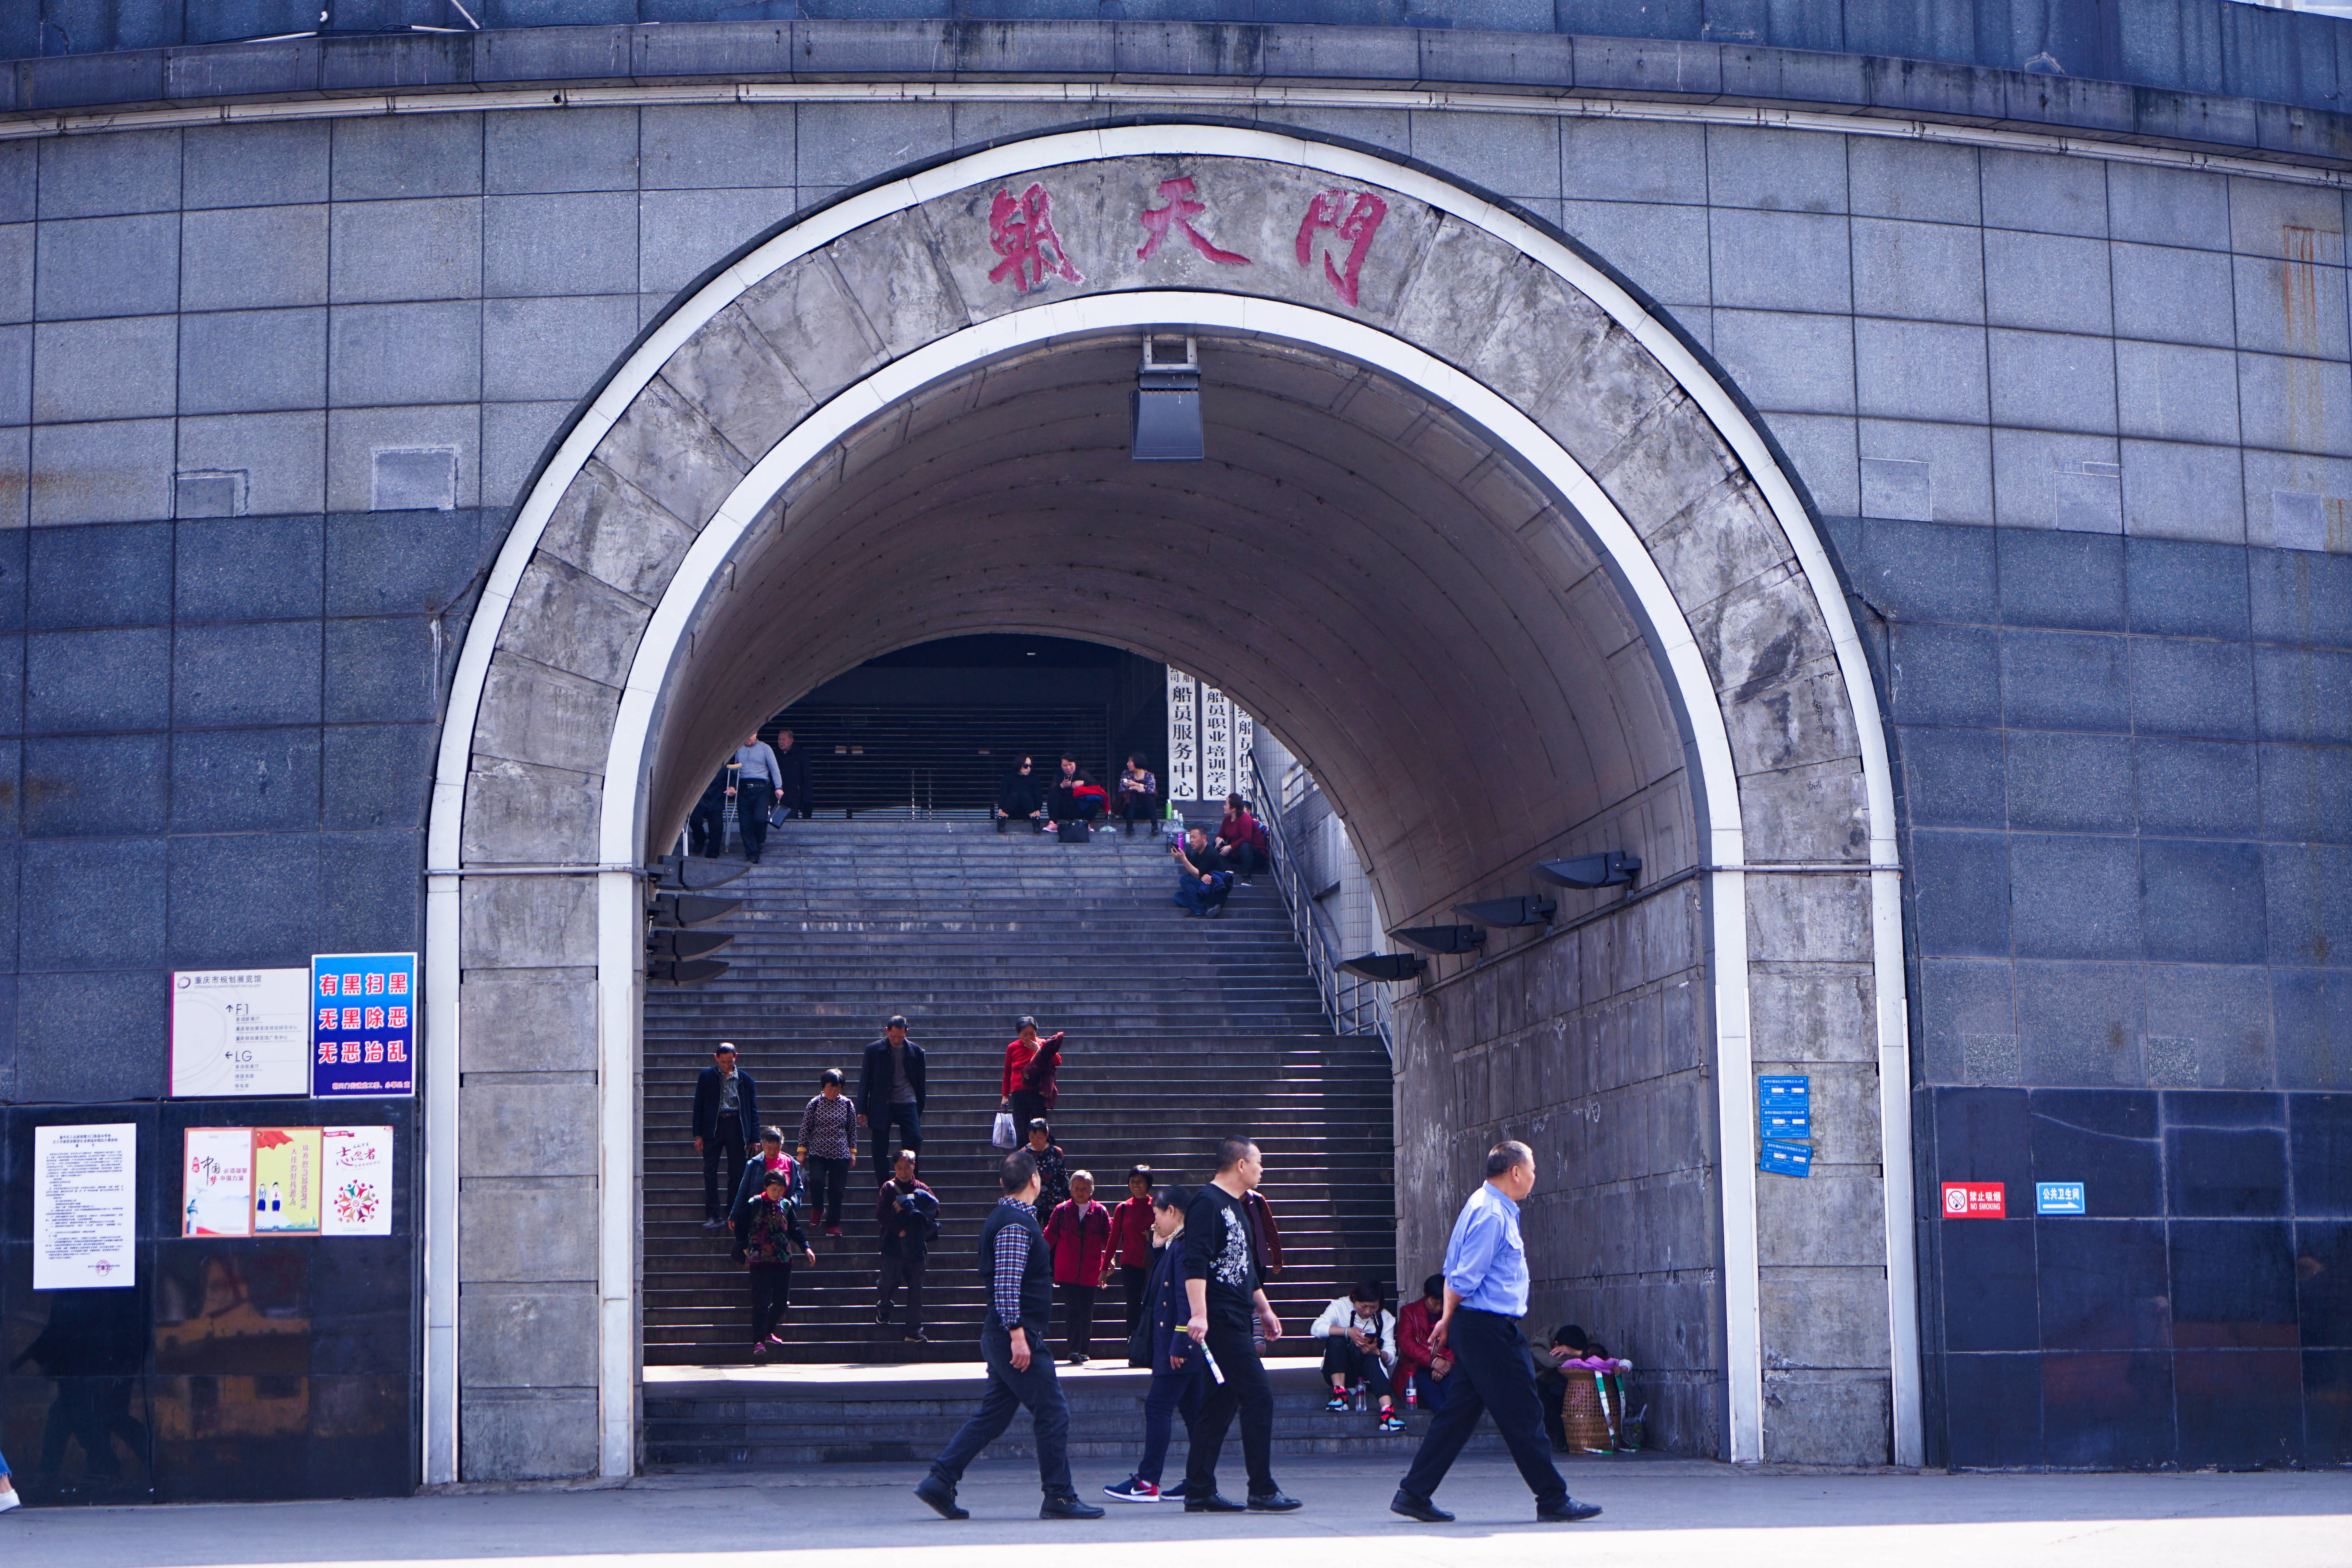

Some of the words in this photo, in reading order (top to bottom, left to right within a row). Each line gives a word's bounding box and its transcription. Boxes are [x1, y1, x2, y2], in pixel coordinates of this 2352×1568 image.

[1172, 686, 1194, 797] 船员服务中心
[1206, 686, 1227, 797] 船员职业培训学校
[194, 975, 262, 984] 重庆市规划展览馆
[320, 972, 408, 996] 有黑扫黑
[236, 1004, 249, 1015] F1
[318, 1006, 408, 1030] 无黑除恶
[235, 1050, 252, 1062] LG
[318, 1039, 407, 1064] 无恶治乱
[336, 1146, 376, 1166] 志愿者
[300, 1144, 309, 1208] 培养担当民族复兴
[1969, 1191, 2001, 1202] 禁止吸烟
[2042, 1187, 2080, 1200] 公共卫生间
